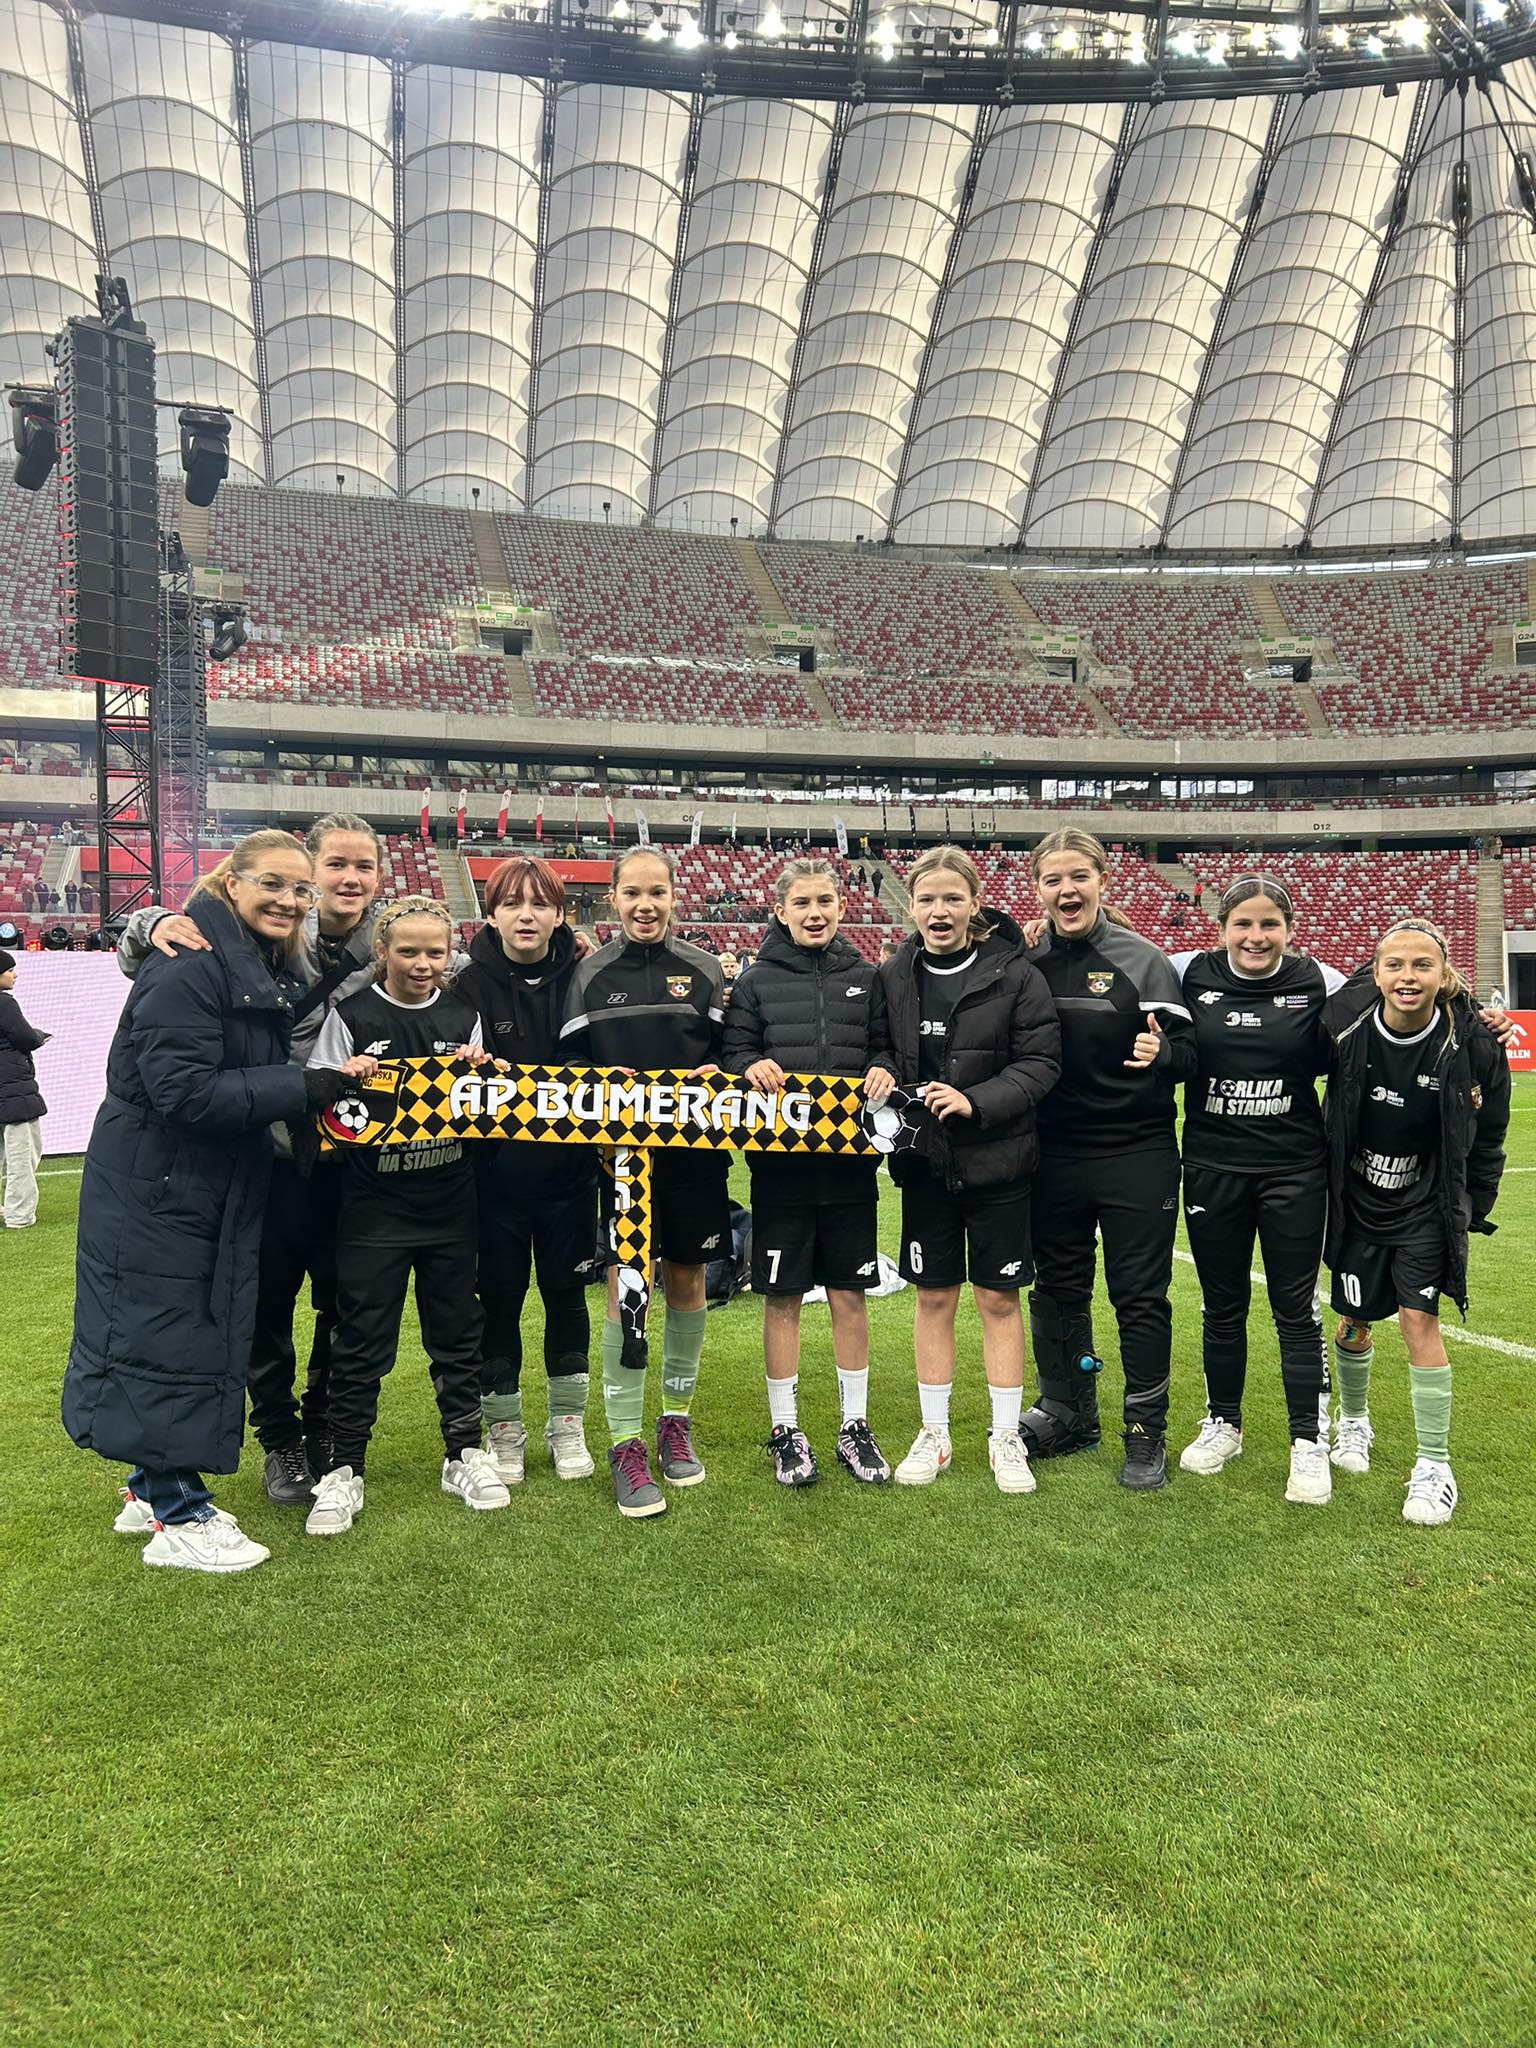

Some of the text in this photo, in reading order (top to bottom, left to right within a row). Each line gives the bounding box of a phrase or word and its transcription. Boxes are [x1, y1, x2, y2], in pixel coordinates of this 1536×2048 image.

[479, 616, 496, 624] G20
[514, 619, 530, 627] G21
[797, 636, 813, 644] G22
[1517, 632, 1535, 640] G24
[1031, 647, 1047, 655] G22
[1295, 647, 1311, 655] G24
[1313, 823, 1331, 831] D12
[1197, 991, 1224, 1005] 4F
[364, 1039, 392, 1055] 4F
[1505, 1049, 1531, 1059] RLEN
[1207, 1077, 1217, 1095] Z
[450, 1074, 812, 1132] AP BUMERANG
[1204, 1095, 1292, 1116] NA STADION
[377, 1141, 463, 1173] NA STADION
[701, 1233, 721, 1249] 4F
[909, 1241, 924, 1274] 6
[574, 1259, 594, 1273] 4F
[766, 1250, 783, 1284] 7
[856, 1260, 876, 1276] 4F
[1000, 1260, 1022, 1276] 4F
[1340, 1272, 1361, 1307] 10
[1419, 1286, 1438, 1300] 4
[664, 1376, 696, 1391] 4F
[603, 1384, 623, 1399] F
